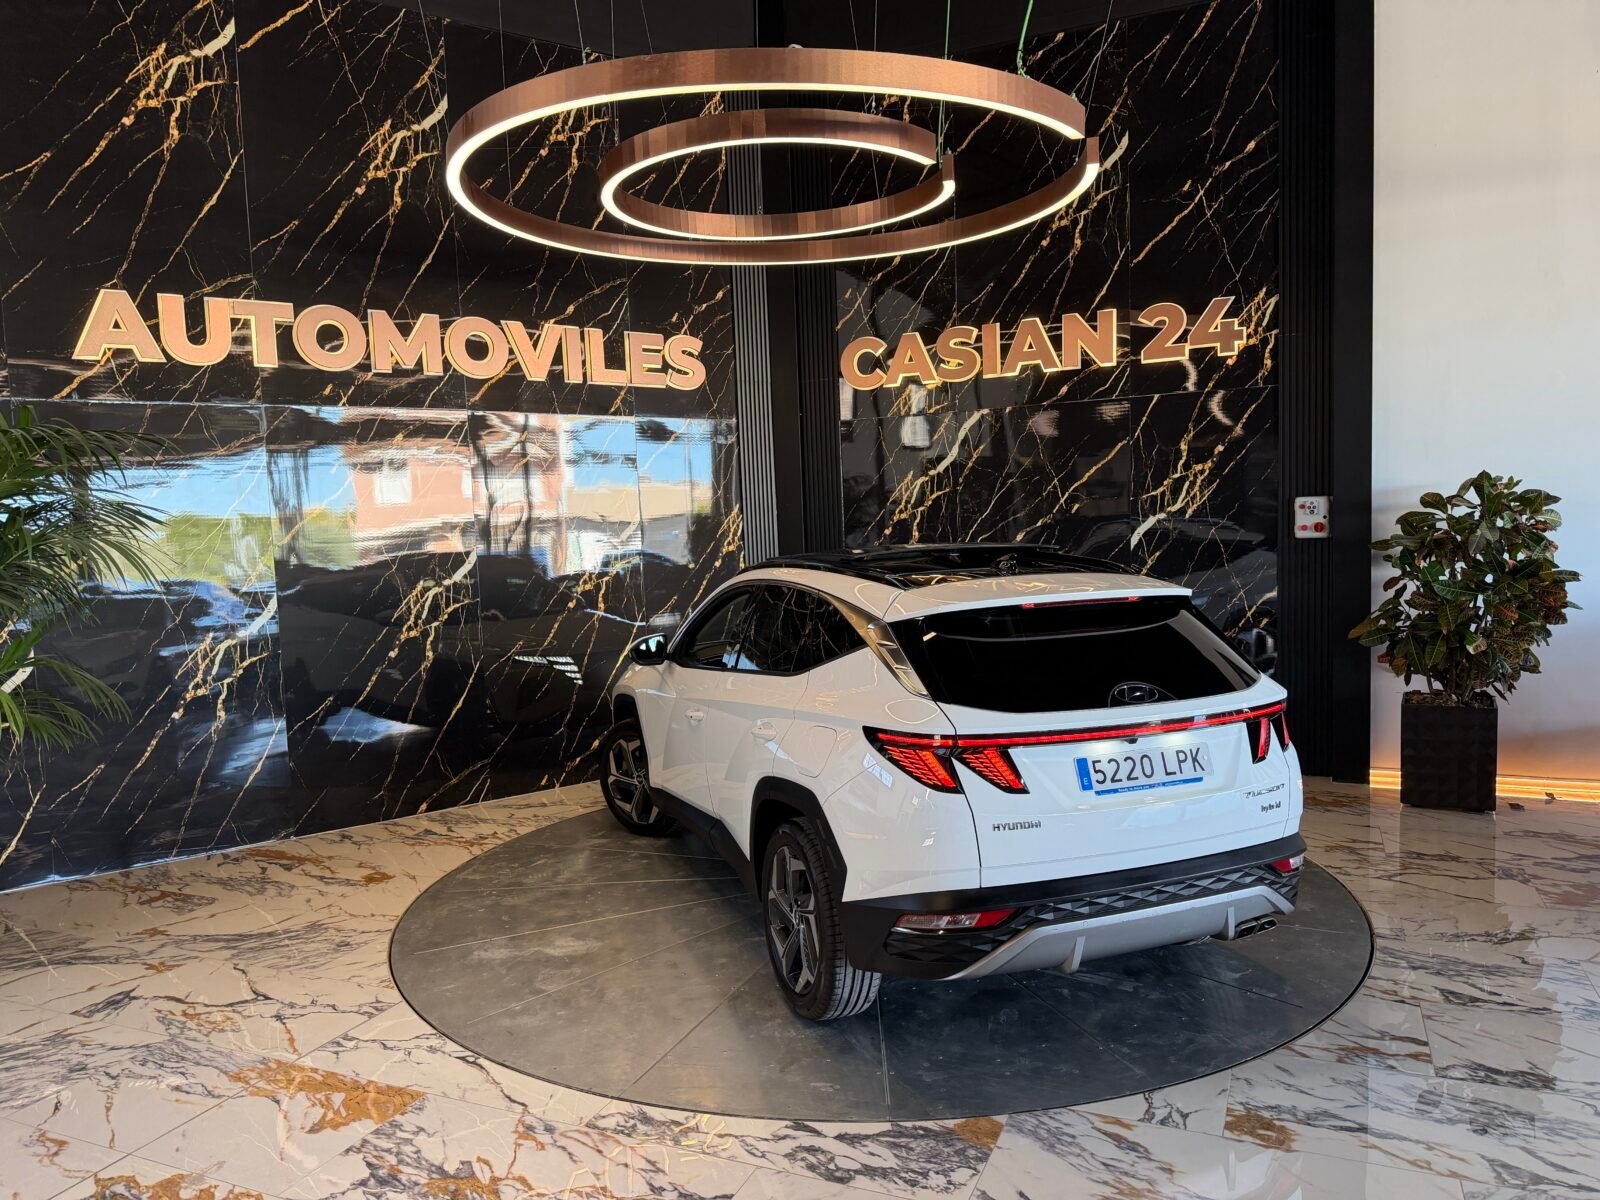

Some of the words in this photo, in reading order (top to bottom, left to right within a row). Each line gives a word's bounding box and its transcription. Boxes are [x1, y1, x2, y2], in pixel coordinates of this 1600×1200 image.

[72, 288, 707, 390] AUTOMOVILES
[840, 308, 1117, 391] CASIAN
[1136, 295, 1247, 364] 24
[1091, 754, 1155, 785] 5220
[1160, 747, 1206, 776] LPK
[992, 820, 1042, 832] HYUNDAI
